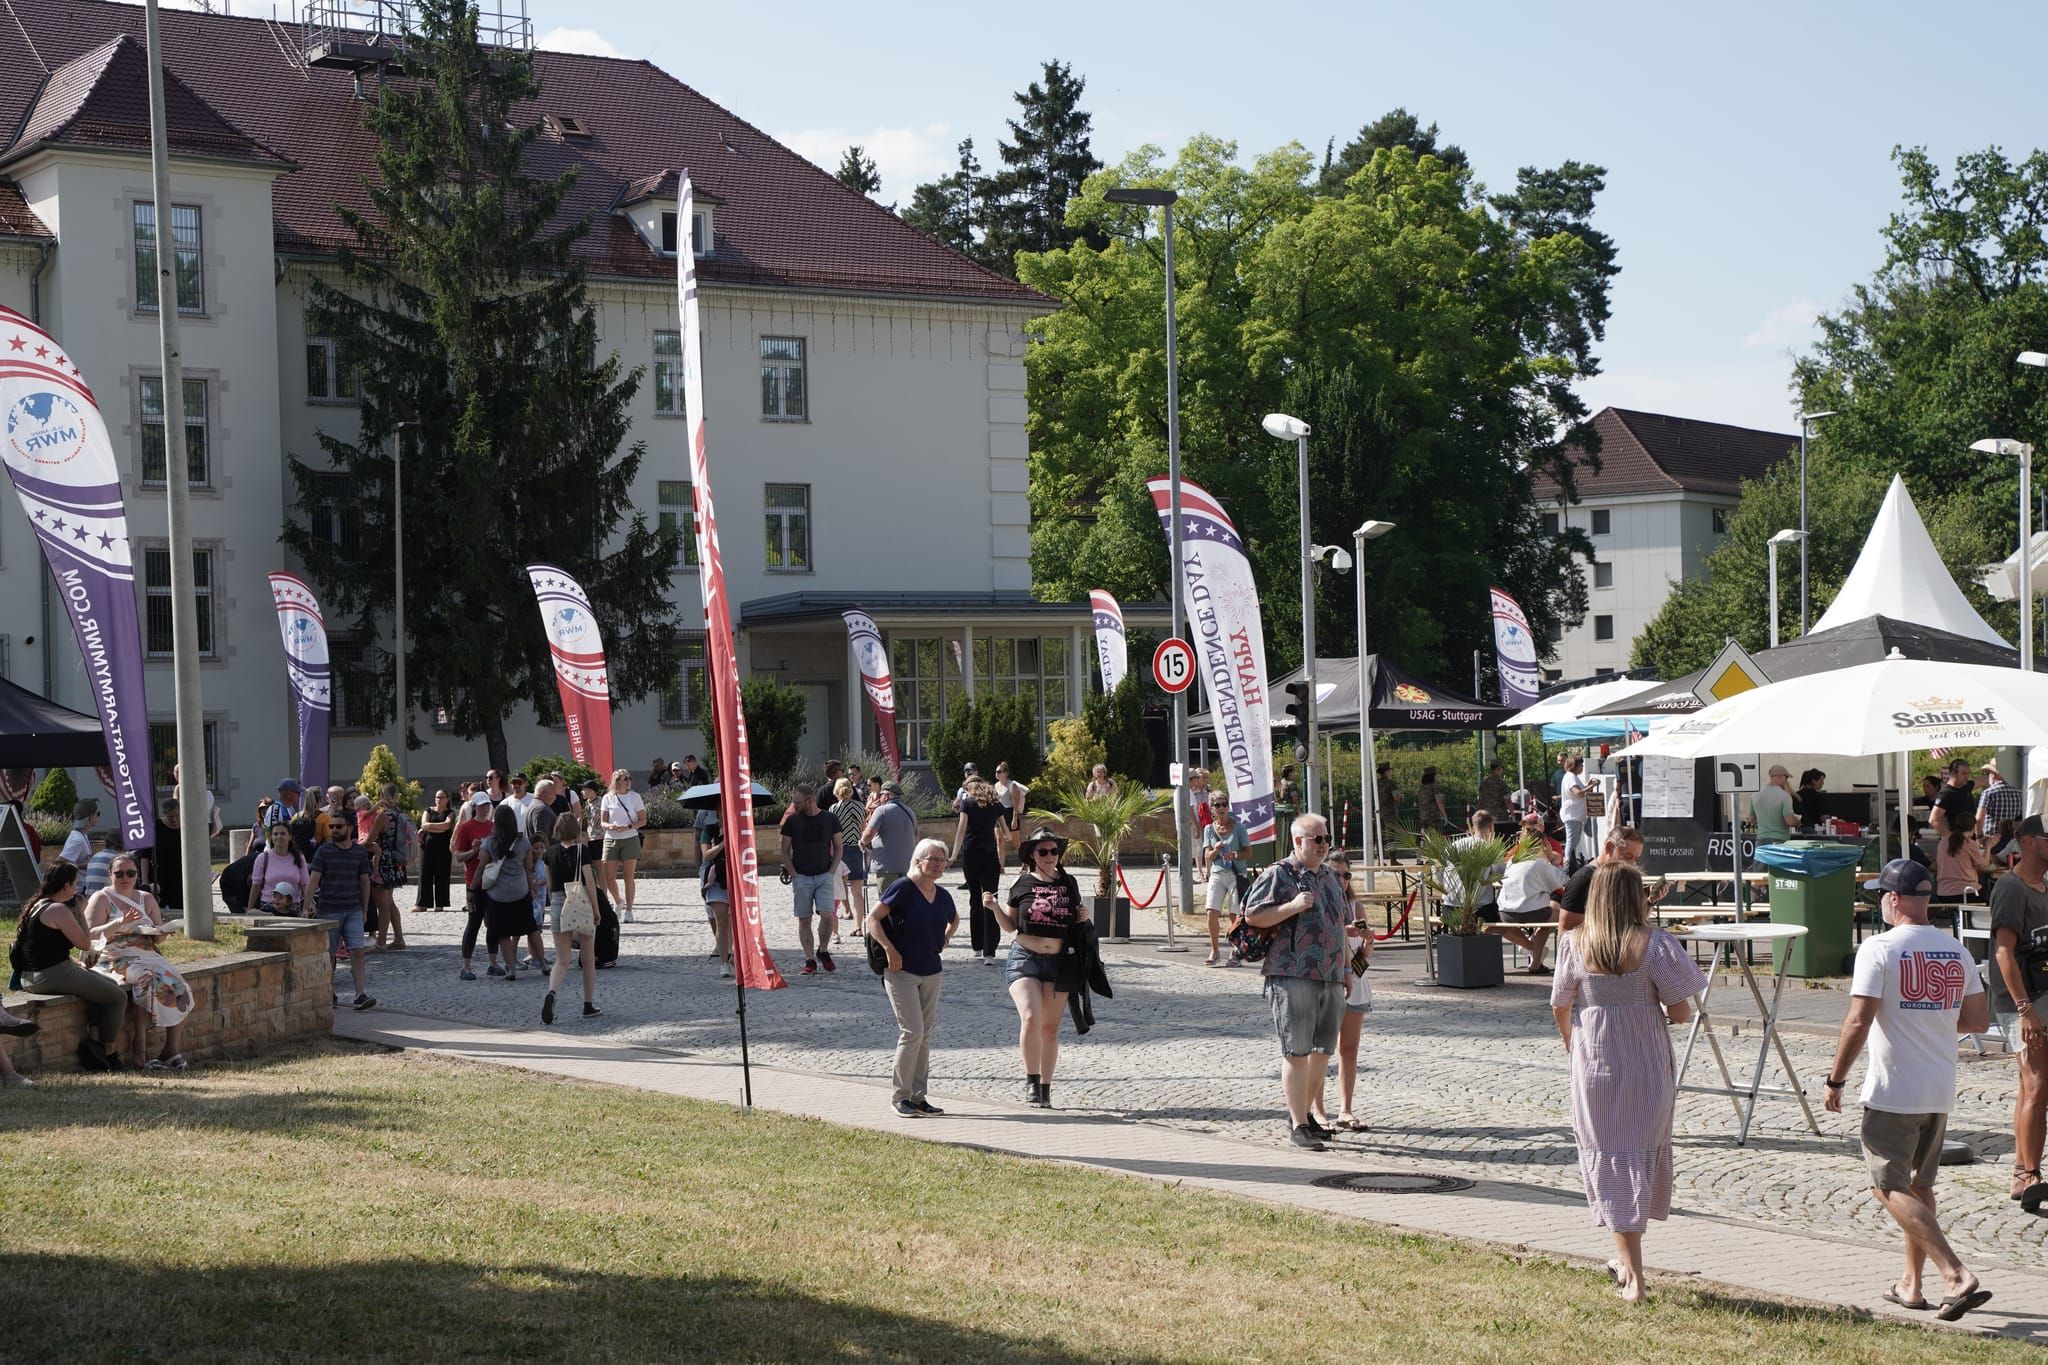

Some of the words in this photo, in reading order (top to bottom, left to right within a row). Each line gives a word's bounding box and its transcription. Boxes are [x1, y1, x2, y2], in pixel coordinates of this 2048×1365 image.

[1164, 654, 1184, 677] 15
[1410, 711, 1435, 720] USAG
[1442, 710, 1483, 723] Stuttgart
[1892, 708, 1998, 728] Schimpf
[1898, 725, 2005, 736] FAMILIENBRAUEREI
[1650, 848, 1668, 856] MONTE
[1707, 838, 1754, 857] RISO
[1900, 951, 1965, 1010] USA
